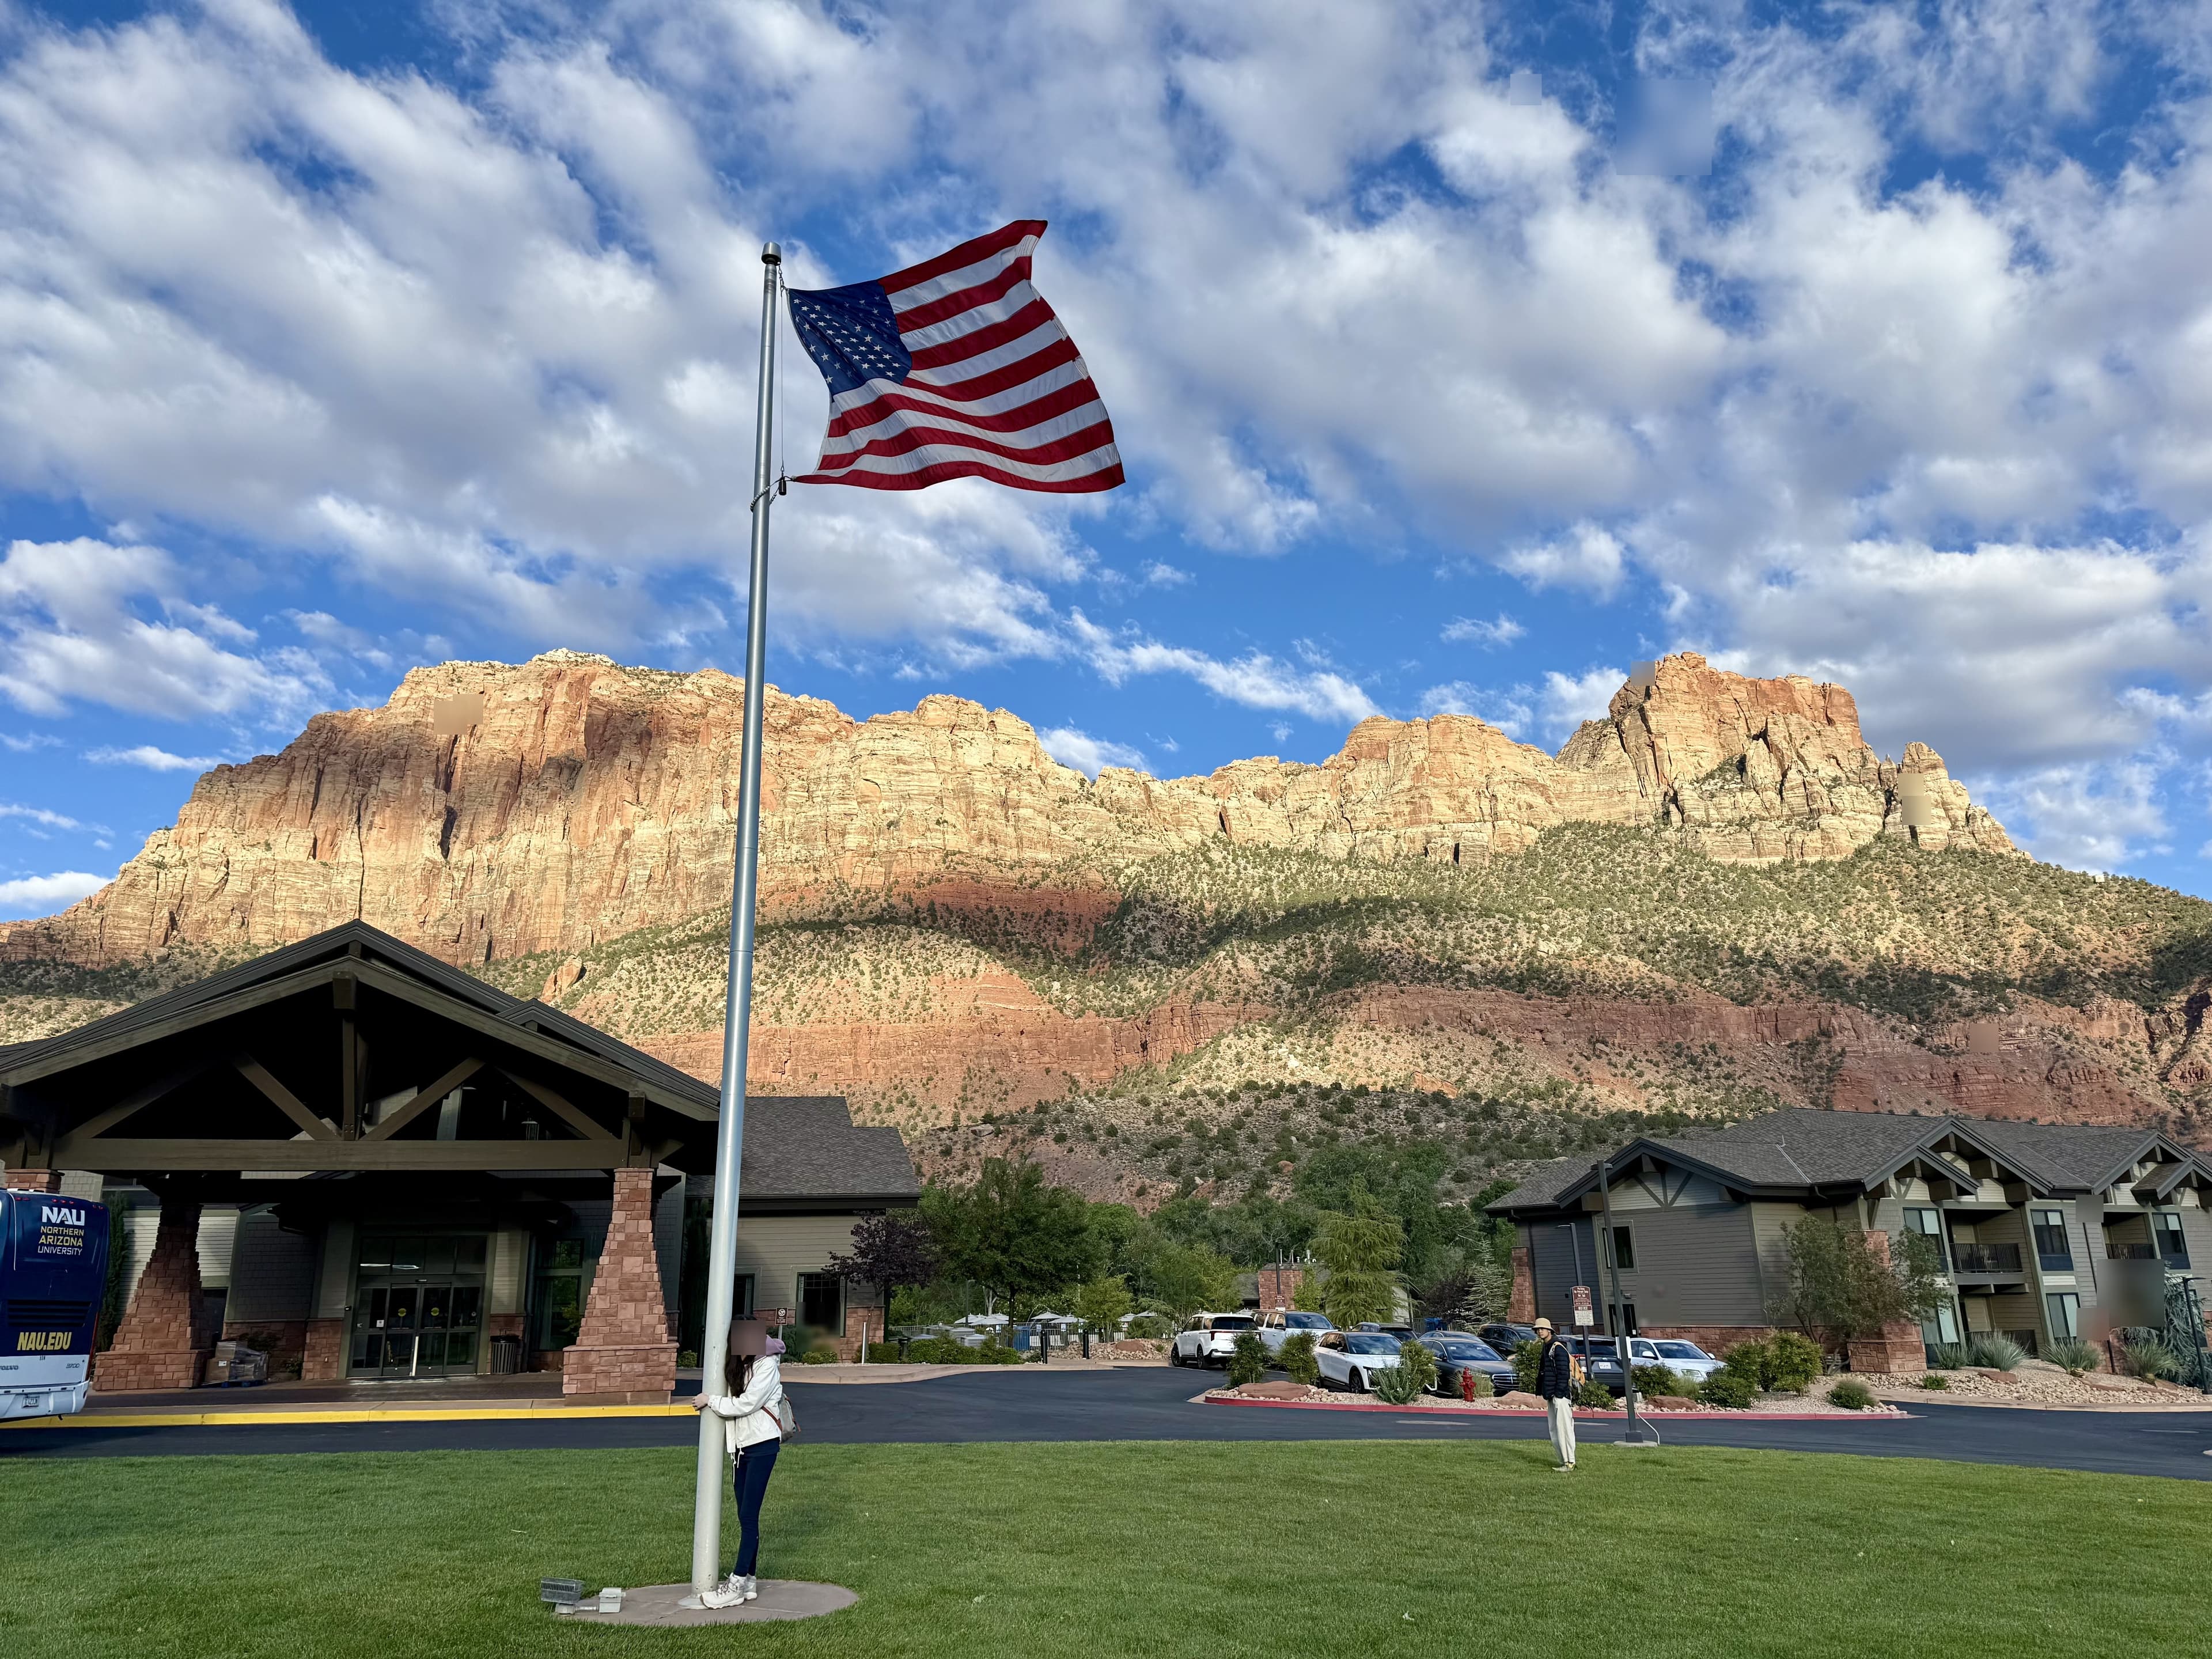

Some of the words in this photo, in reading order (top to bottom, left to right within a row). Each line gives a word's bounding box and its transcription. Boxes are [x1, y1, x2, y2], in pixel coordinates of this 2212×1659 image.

[41, 1206, 85, 1226] NAU
[40, 1226, 84, 1236] NORTHERN
[39, 1234, 83, 1247] ARIZONA
[37, 1245, 82, 1256] UNIVERSITY
[17, 1332, 72, 1351] NAU.EDU
